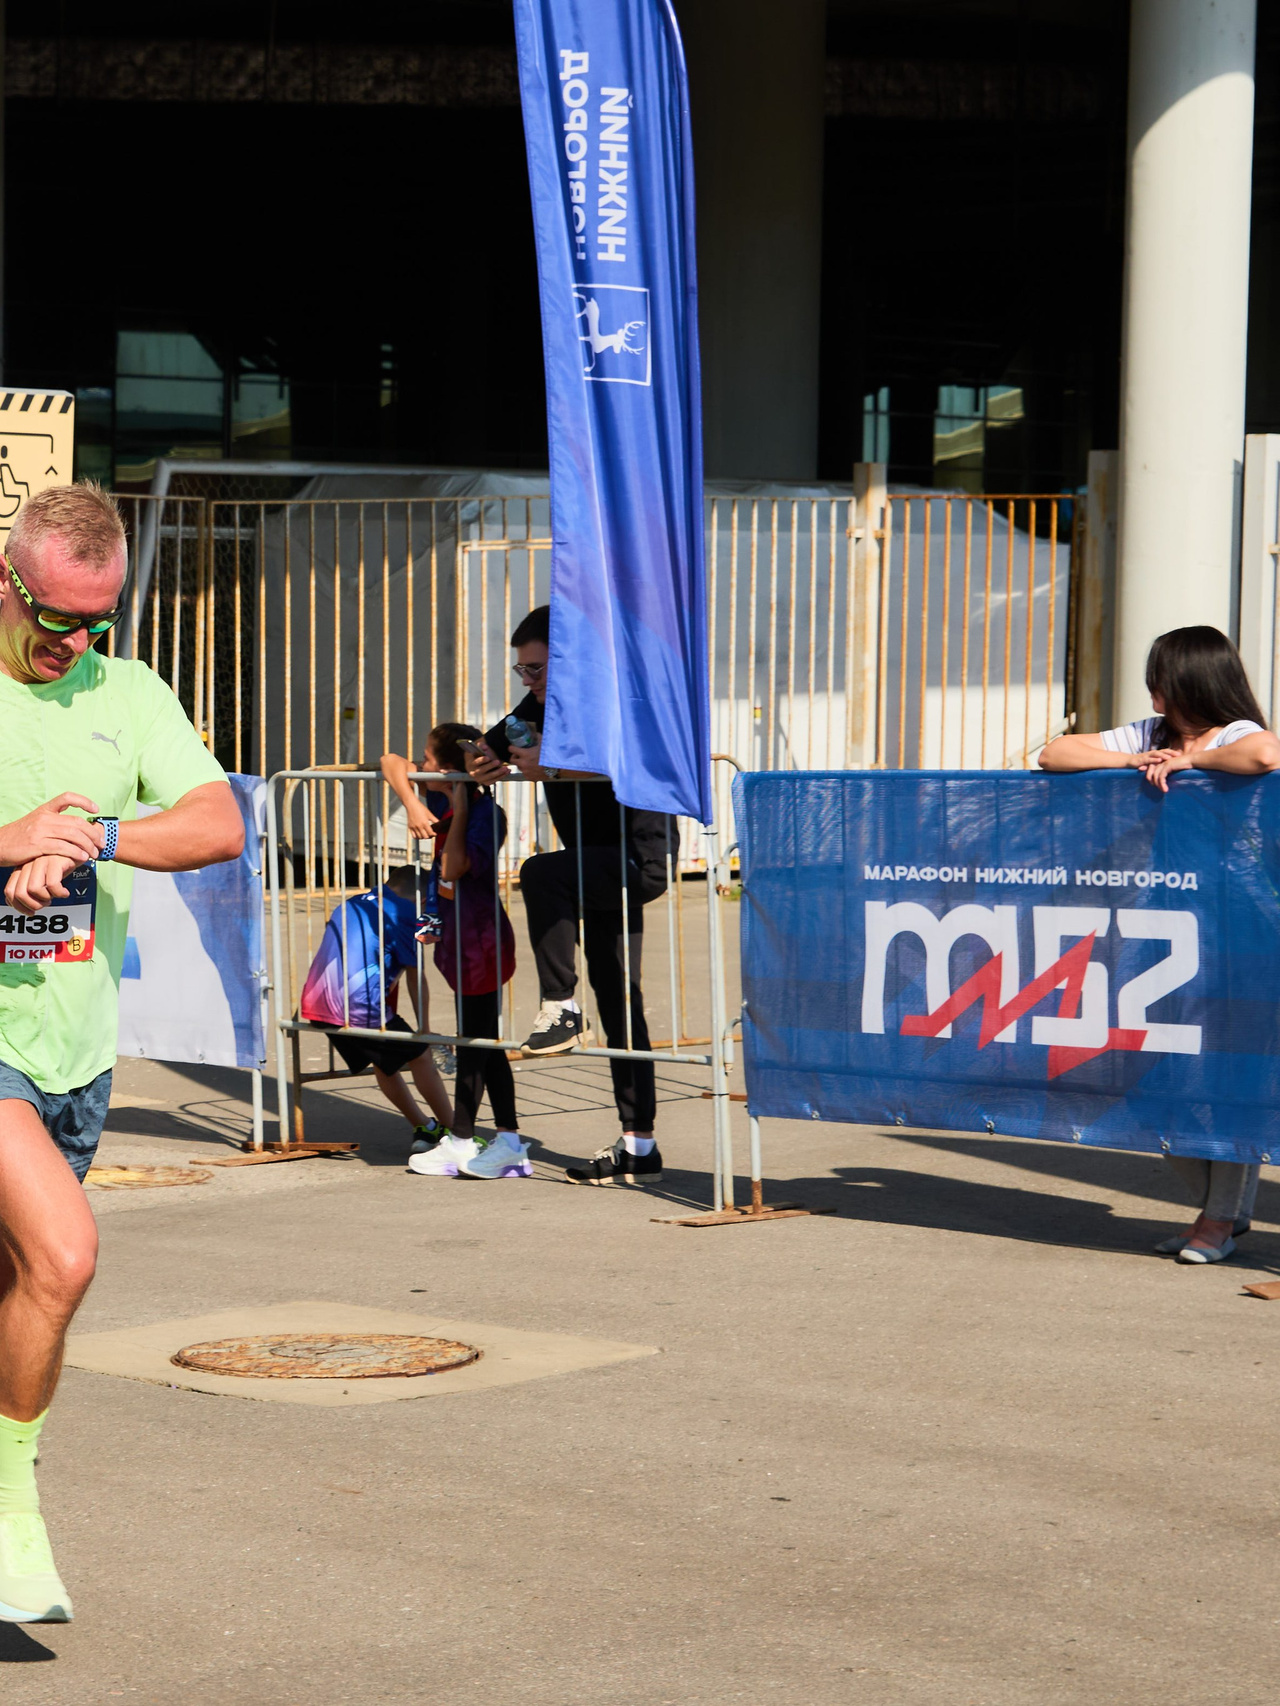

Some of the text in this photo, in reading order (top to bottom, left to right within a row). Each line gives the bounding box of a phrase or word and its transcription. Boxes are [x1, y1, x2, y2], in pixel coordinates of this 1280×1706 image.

[864, 865, 1198, 890] МАРАФОН НИЖНИЙ НОВГОРОД
[7, 949, 26, 959] 10
